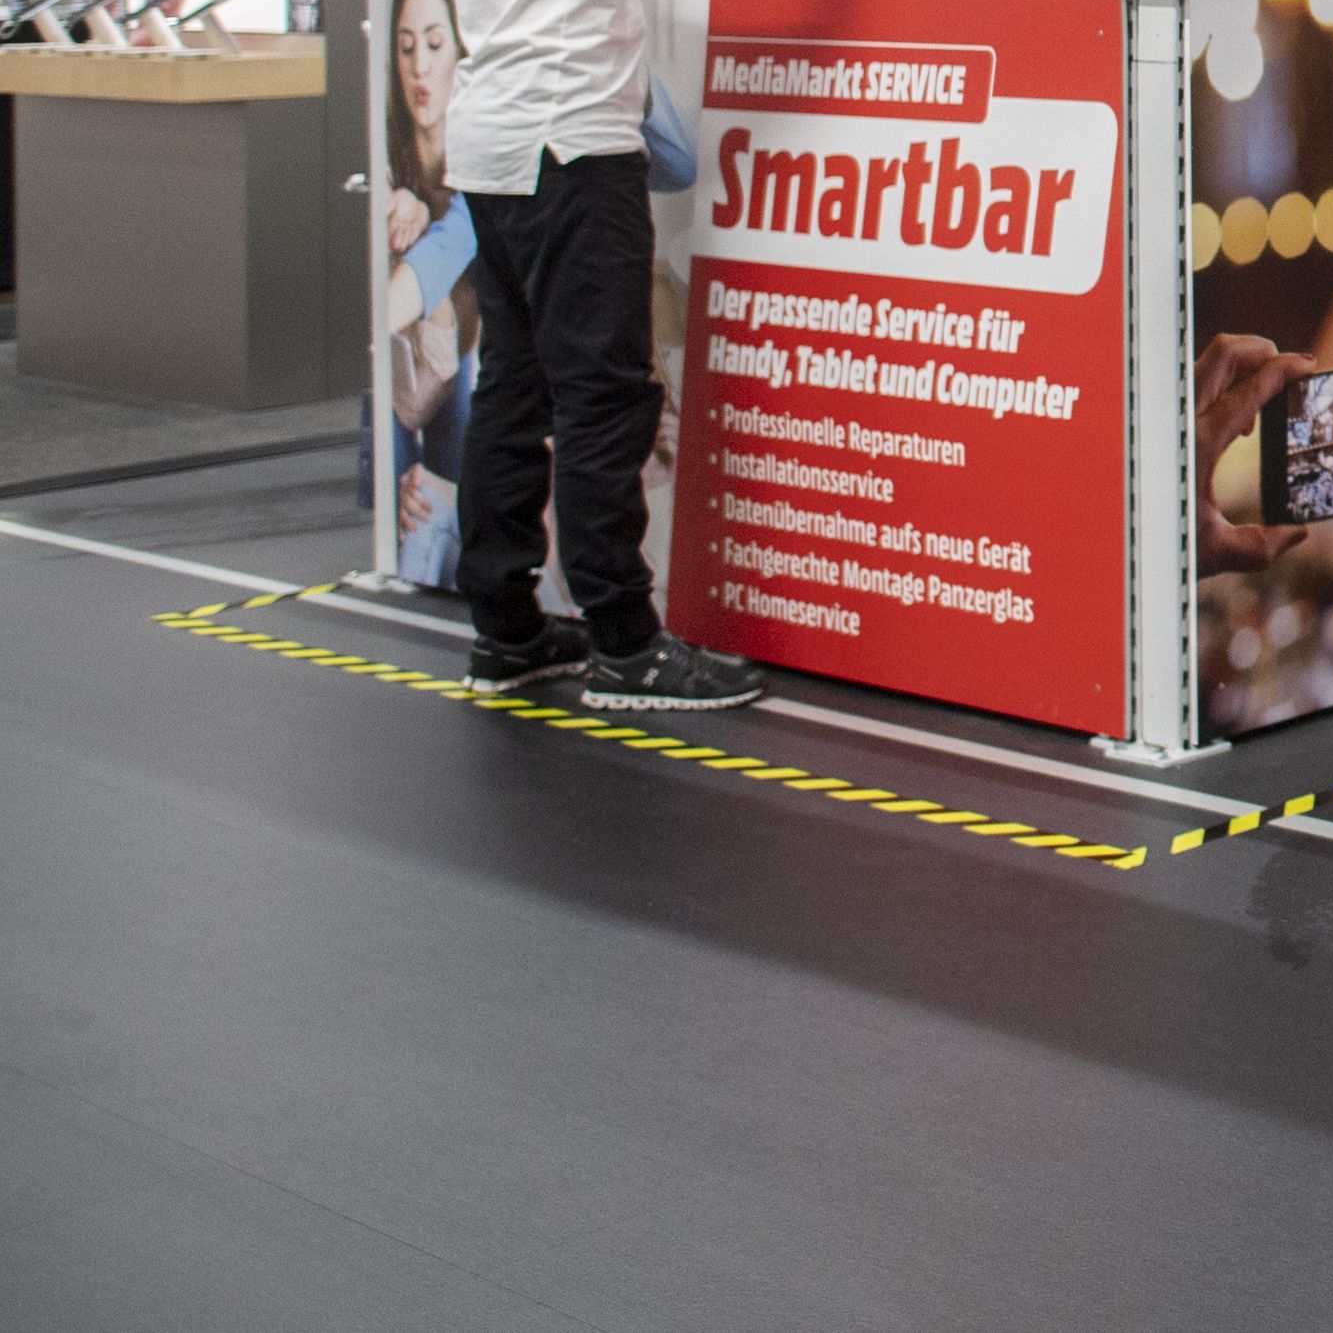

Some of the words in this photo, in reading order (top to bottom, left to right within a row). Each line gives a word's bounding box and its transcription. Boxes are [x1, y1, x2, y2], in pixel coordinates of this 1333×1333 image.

[711, 54, 865, 100] MediaMarkt
[865, 62, 967, 106] SERVICE
[712, 126, 1076, 259] Smartbar
[708, 280, 751, 322] Der
[751, 293, 873, 337] passende
[875, 298, 975, 347] Service
[978, 308, 1025, 354] für
[708, 336, 792, 389] Handy,
[796, 345, 878, 395] Tablet
[880, 359, 935, 401] und
[937, 363, 1080, 420] Computer
[723, 405, 846, 450] Professionelle
[849, 421, 966, 467] Reparaturen
[723, 449, 894, 504] Installationsservice
[723, 493, 877, 548] Datenübernahme
[880, 521, 922, 557] aufs
[925, 532, 975, 565] neue
[978, 537, 1031, 575] Gerät
[723, 536, 840, 587] Fachgerechte
[843, 560, 924, 606] Montage
[928, 574, 1035, 625] Panzerglas
[723, 580, 746, 613] PC
[748, 590, 861, 636] Homeservice
